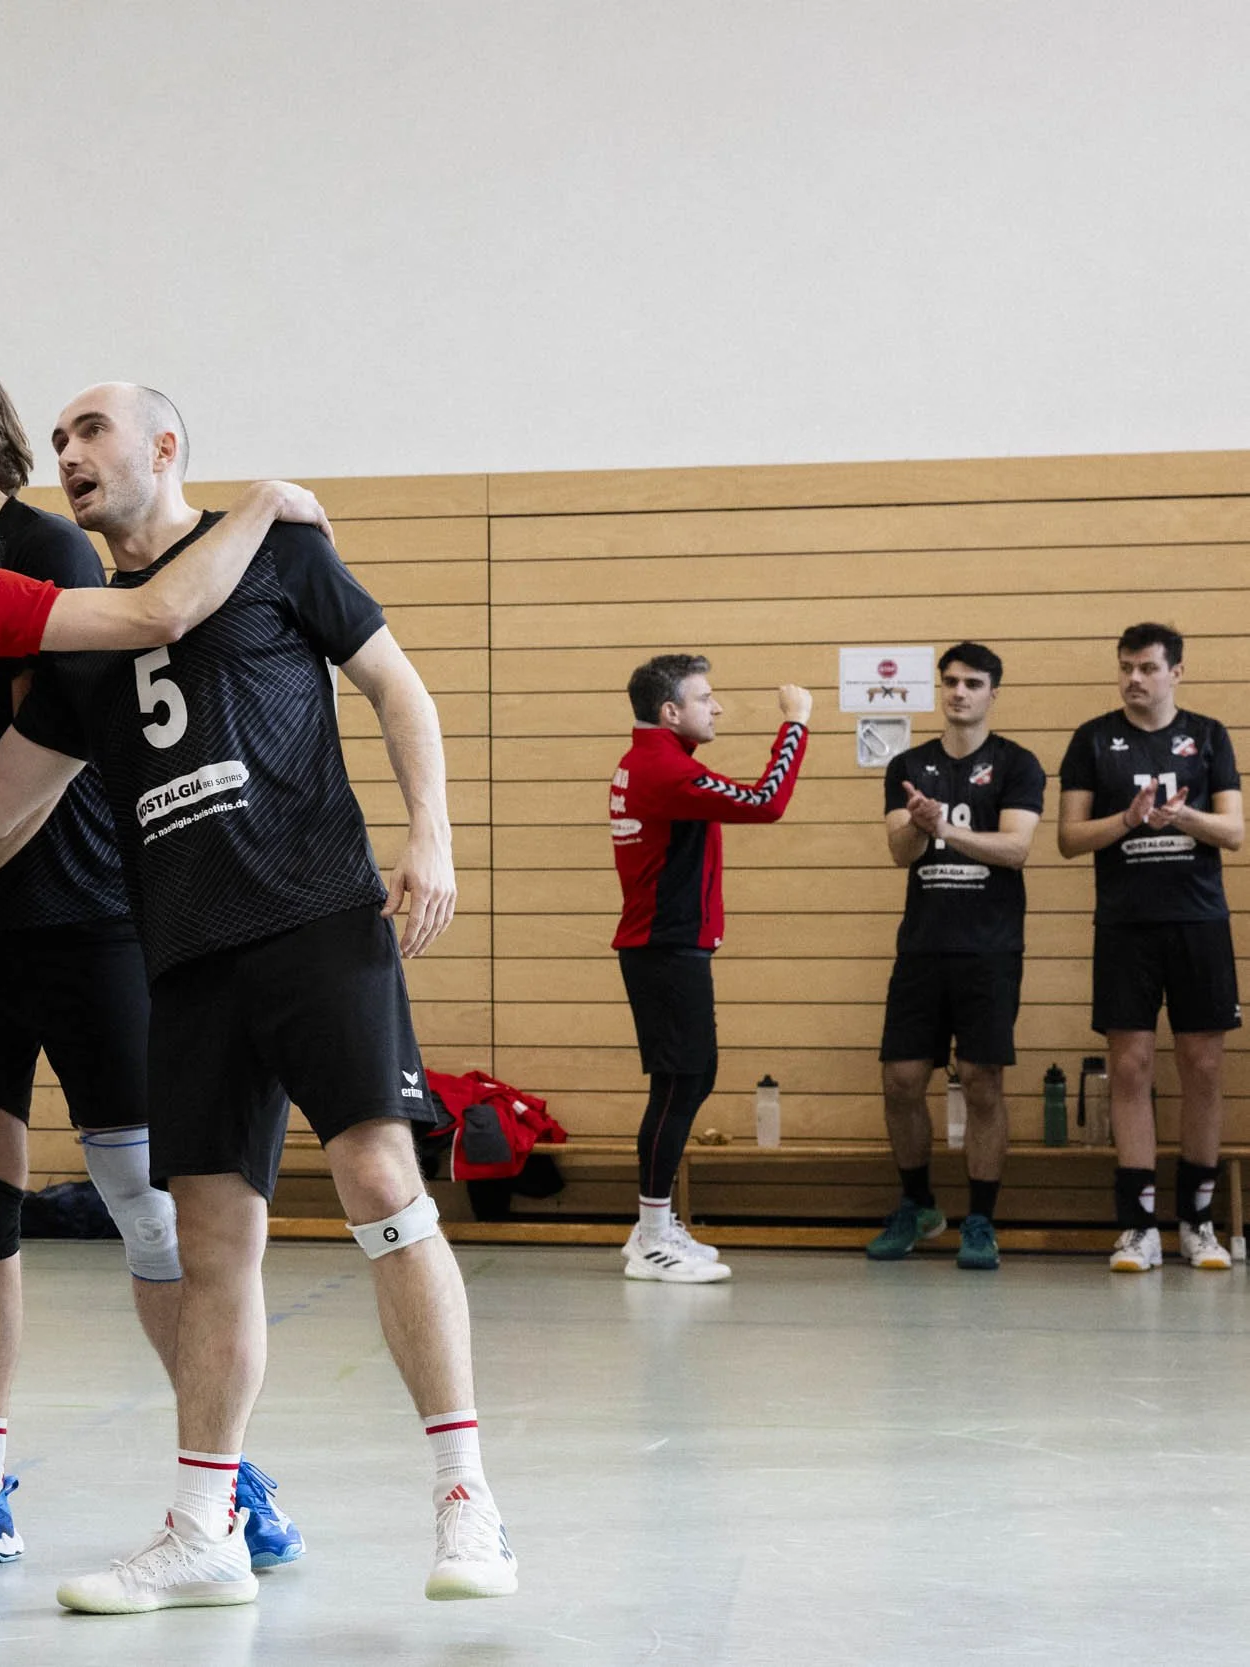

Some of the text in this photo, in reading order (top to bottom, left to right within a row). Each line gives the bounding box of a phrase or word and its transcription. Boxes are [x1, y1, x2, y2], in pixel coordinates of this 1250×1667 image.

[134, 646, 188, 749] 5
[138, 773, 243, 820] NOSTALGIA BEI SOTIRIS
